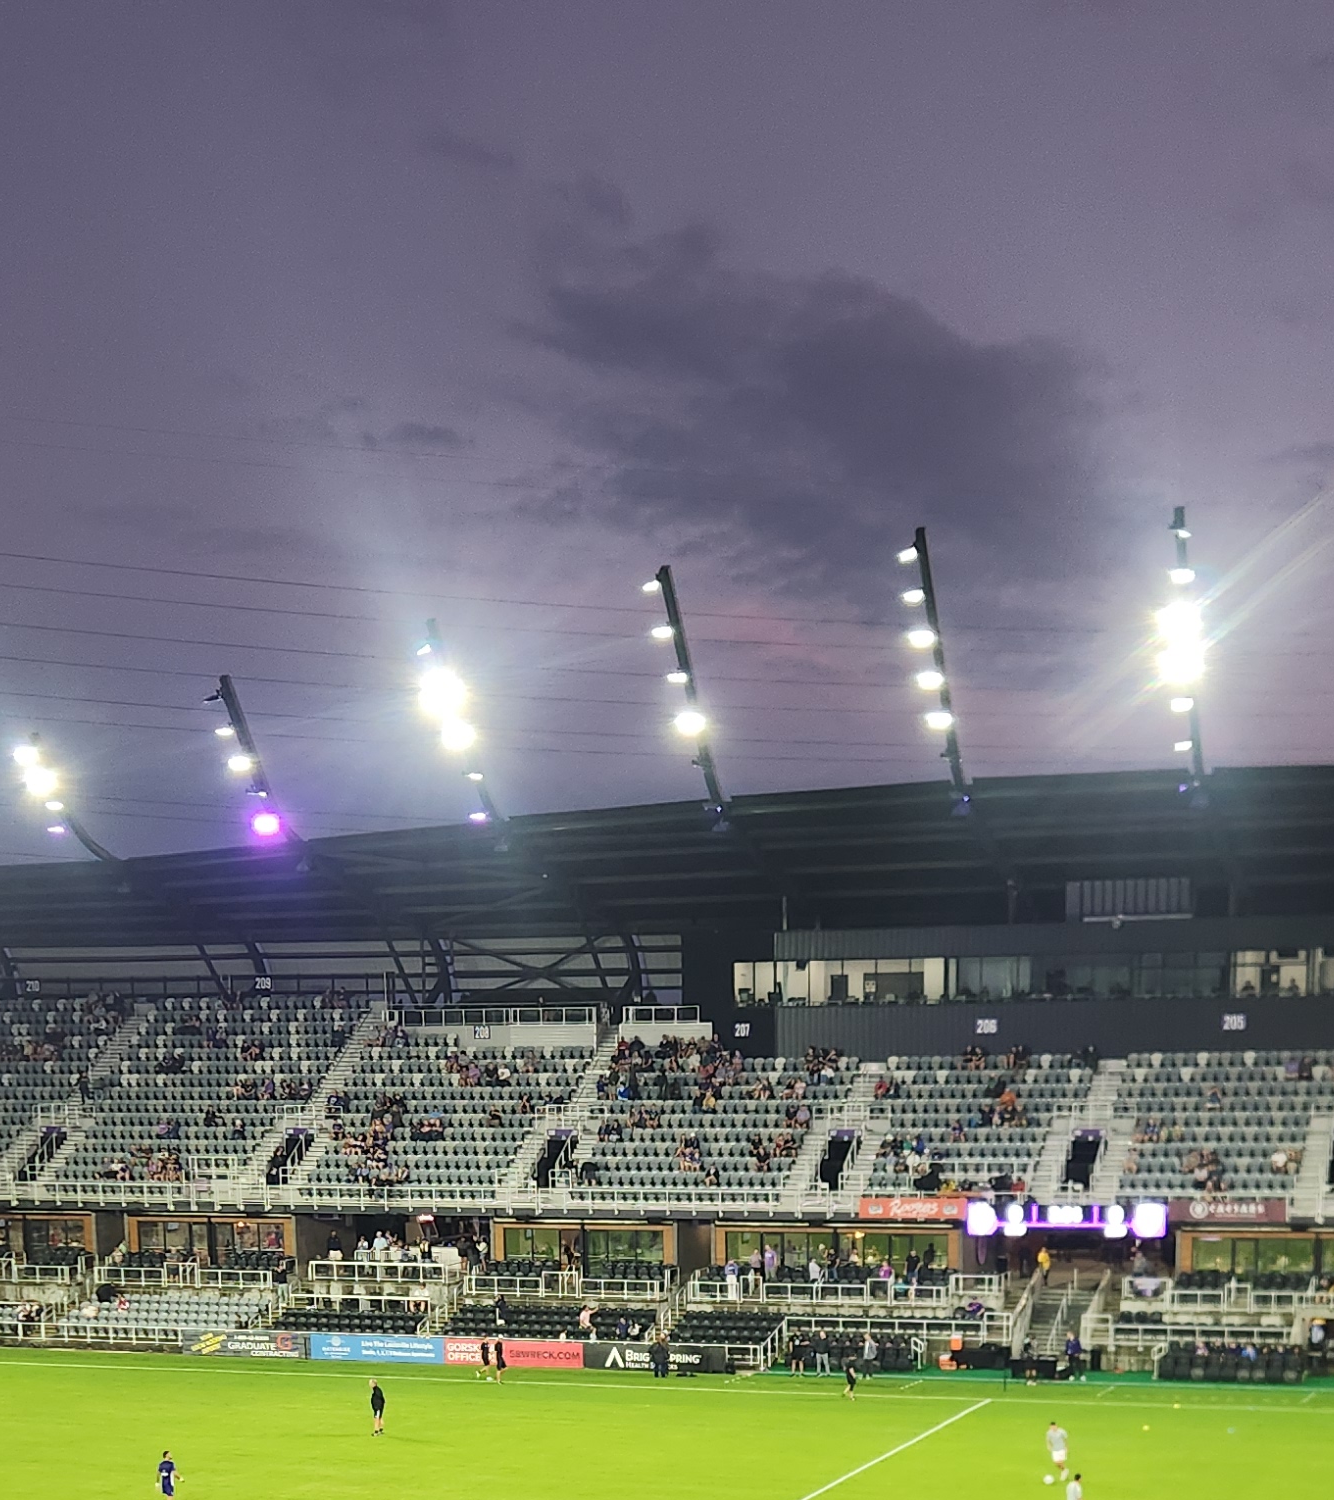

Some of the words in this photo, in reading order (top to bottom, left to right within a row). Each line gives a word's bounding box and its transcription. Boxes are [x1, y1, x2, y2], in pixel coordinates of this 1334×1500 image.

[255, 977, 271, 989] 209
[1223, 1014, 1246, 1031] 205
[734, 1023, 750, 1037] 207
[227, 1341, 276, 1351] GRADUATE
[447, 1343, 482, 1352] GORSK
